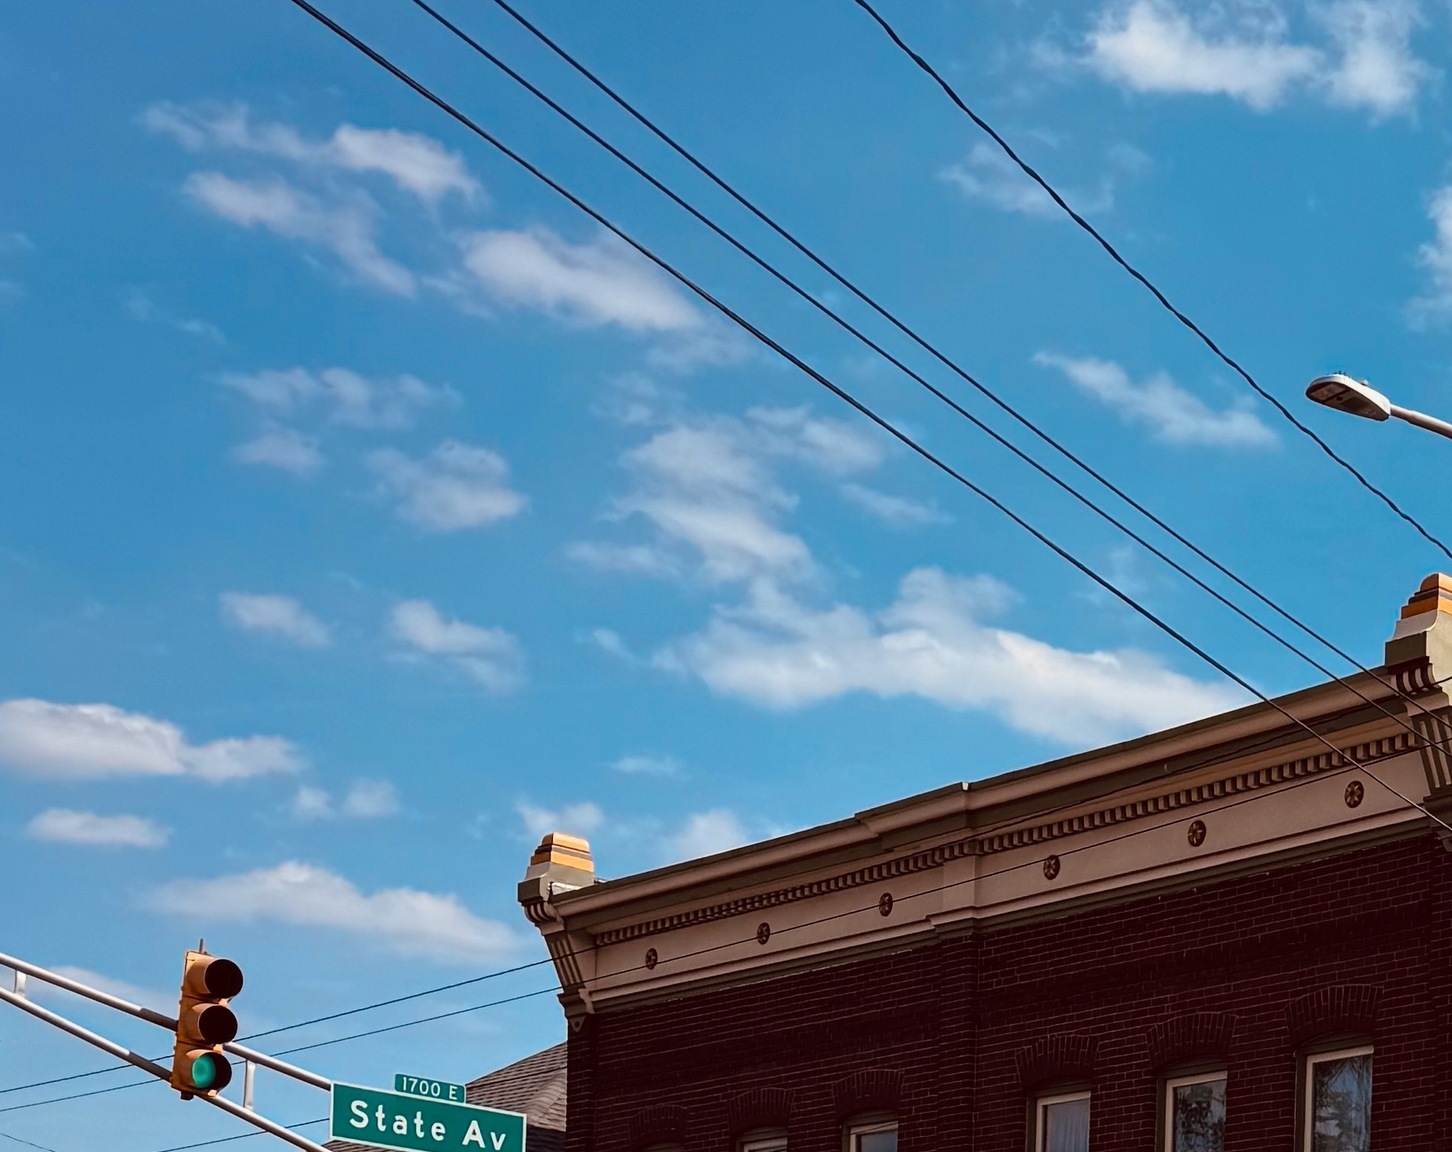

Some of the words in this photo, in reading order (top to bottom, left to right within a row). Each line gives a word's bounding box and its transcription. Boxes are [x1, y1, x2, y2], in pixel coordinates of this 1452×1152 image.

[402, 1076, 441, 1097] 1700
[448, 1086, 458, 1101] E
[349, 1099, 446, 1142] State
[461, 1119, 507, 1151] Av
